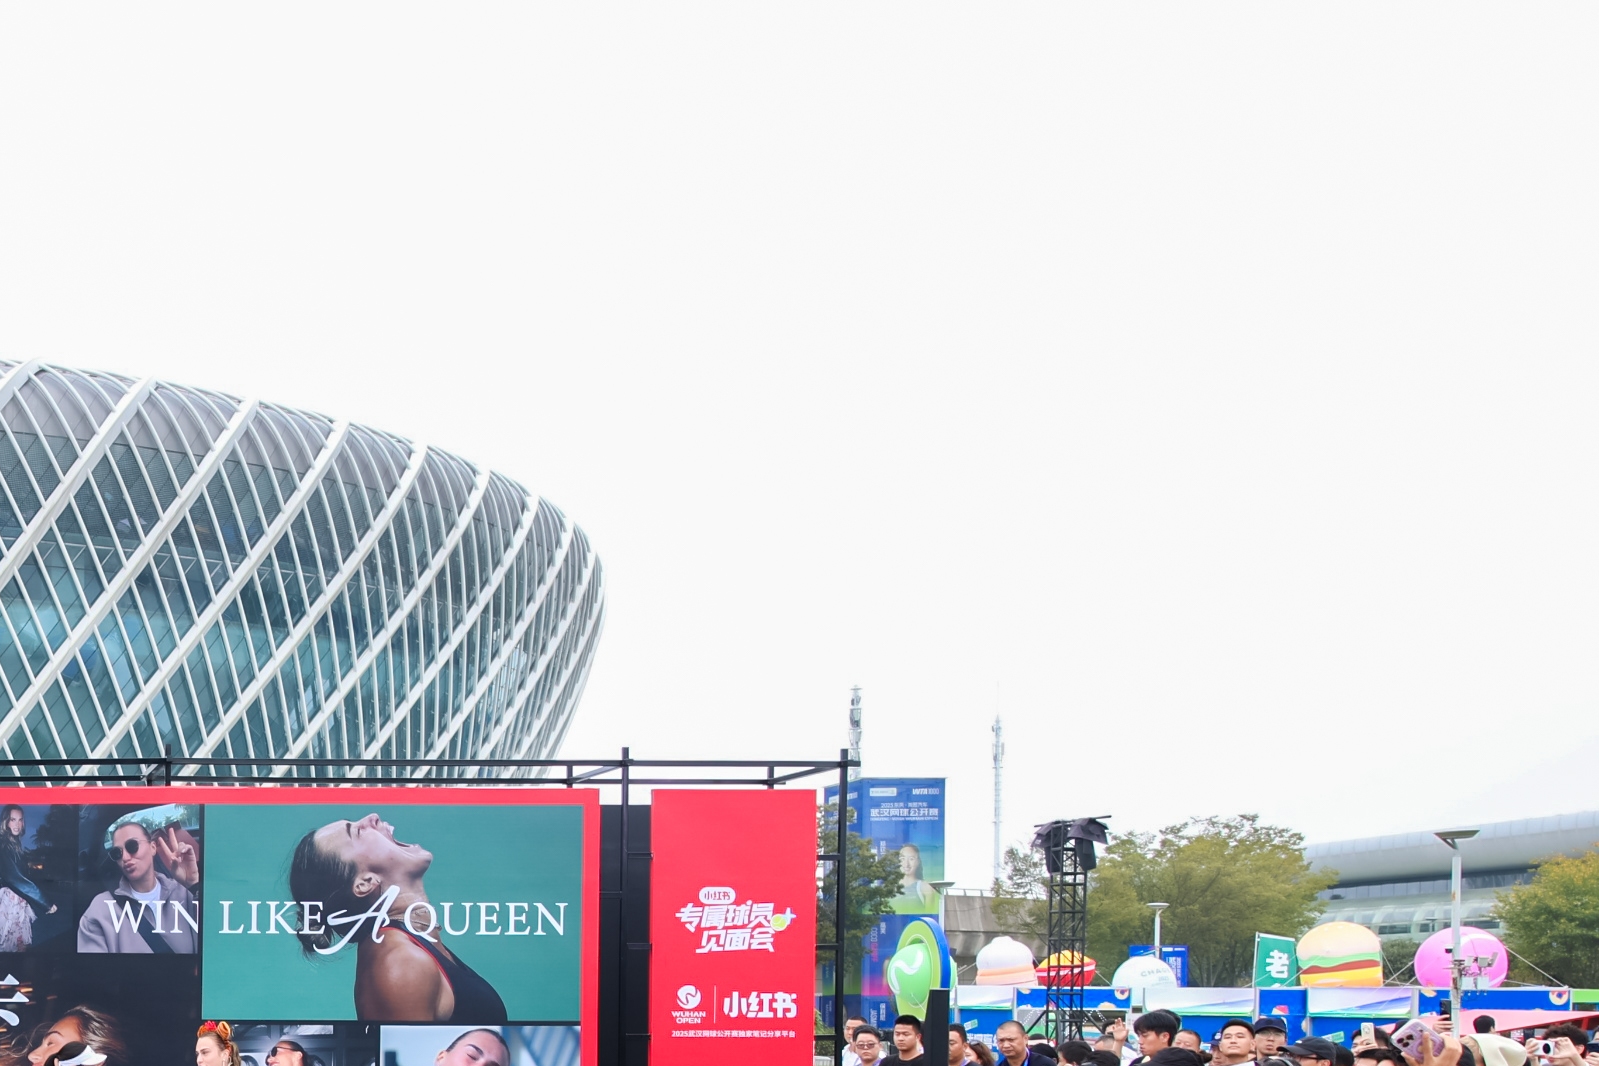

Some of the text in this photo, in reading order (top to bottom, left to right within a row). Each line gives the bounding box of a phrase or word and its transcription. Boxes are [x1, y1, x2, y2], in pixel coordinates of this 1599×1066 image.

[104, 885, 569, 955] WIN LIKE A QUEEN
[675, 900, 775, 933] 专属球员
[696, 927, 775, 954] 见面会
[1265, 949, 1290, 979] 老
[723, 991, 798, 1019] 小红书
